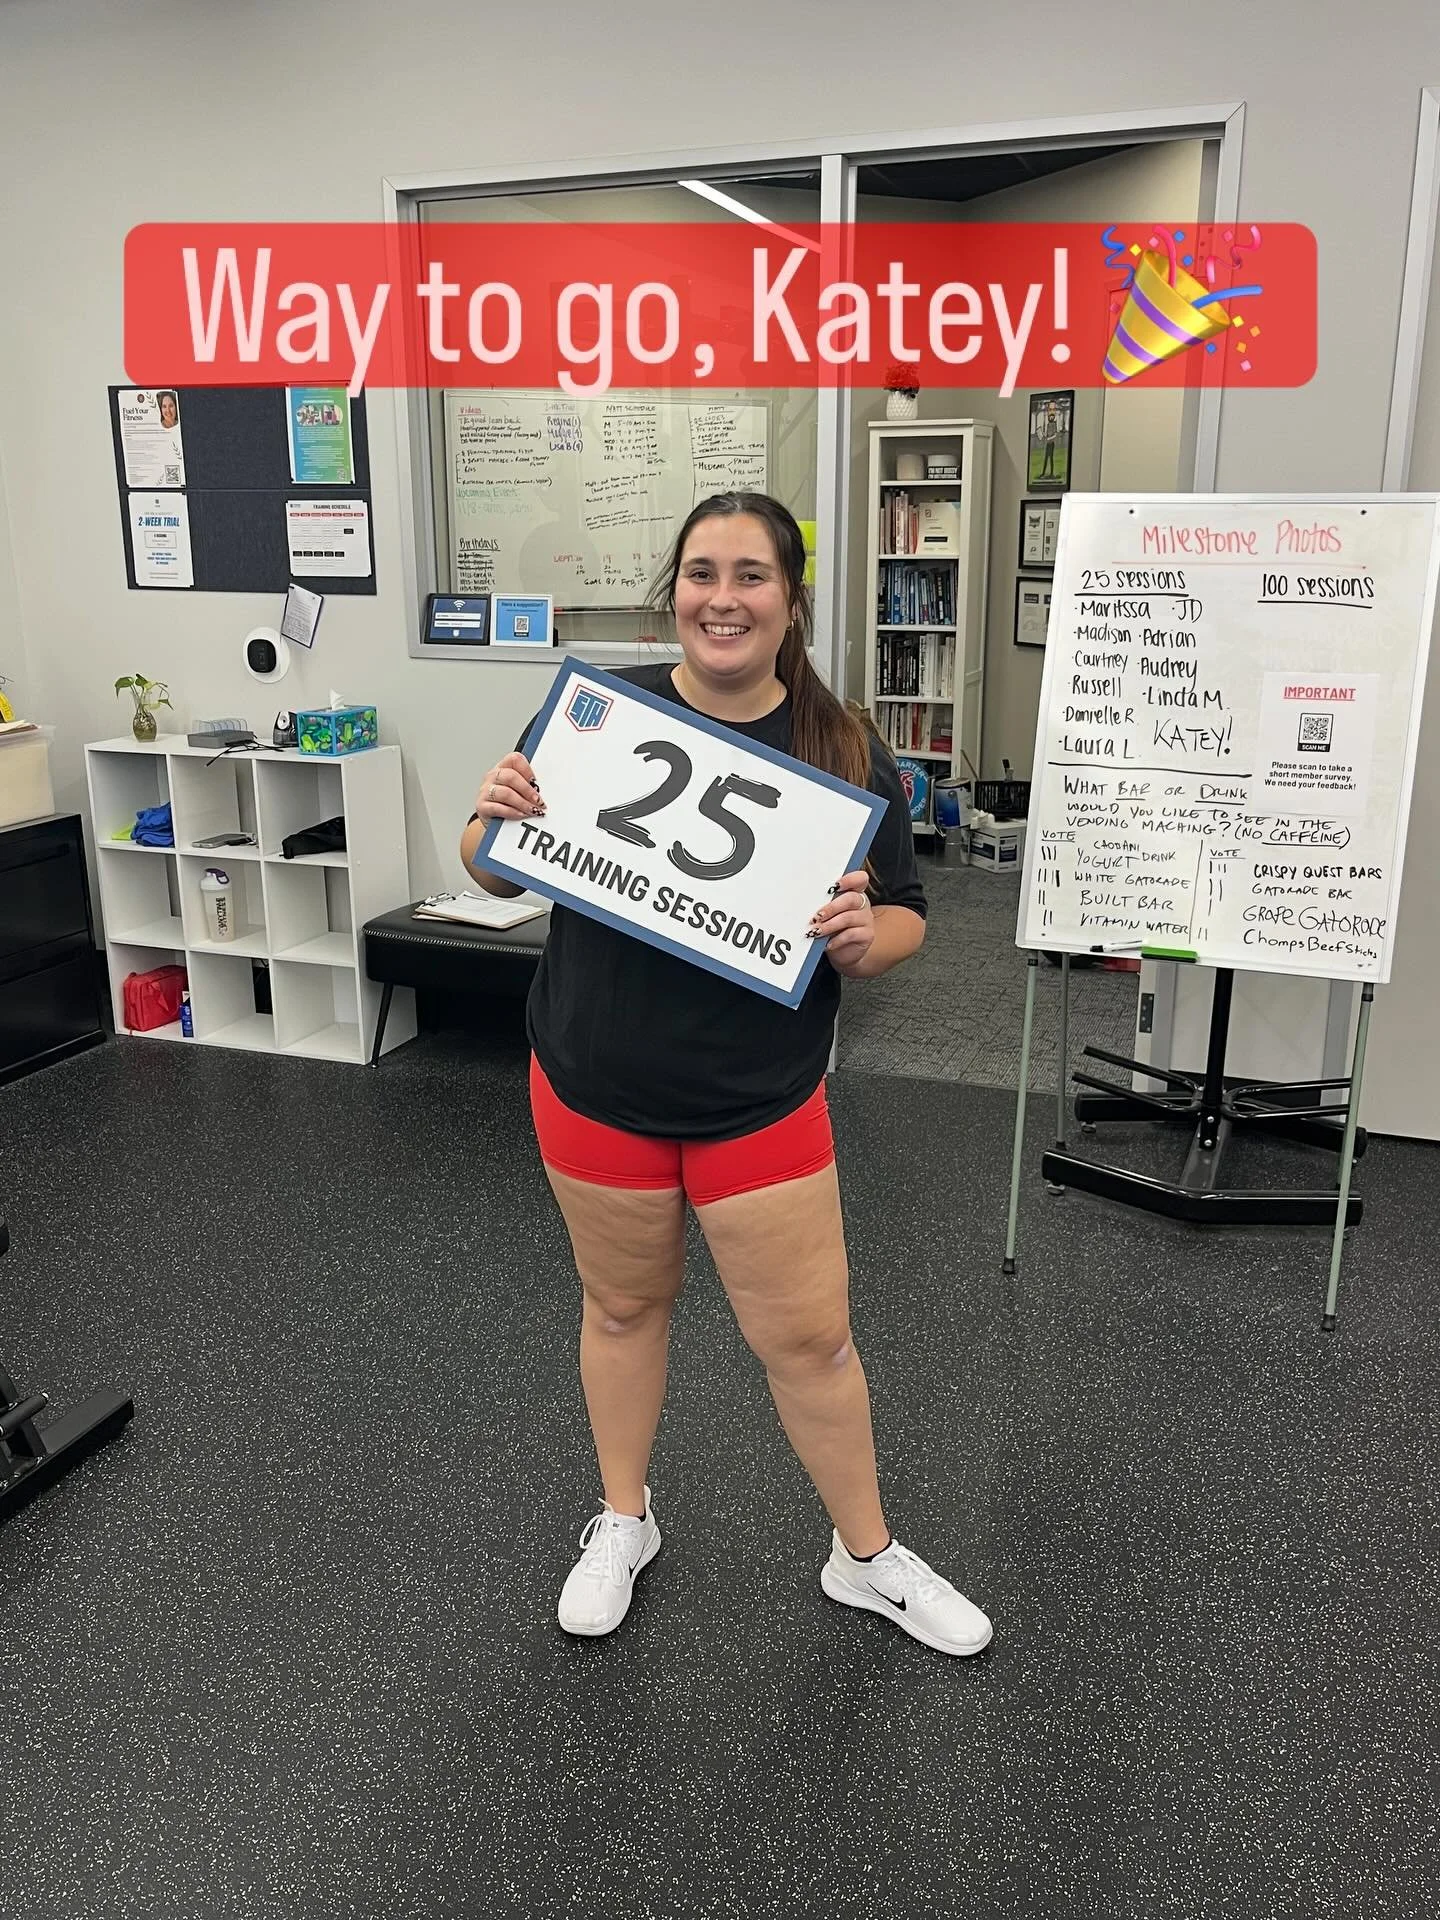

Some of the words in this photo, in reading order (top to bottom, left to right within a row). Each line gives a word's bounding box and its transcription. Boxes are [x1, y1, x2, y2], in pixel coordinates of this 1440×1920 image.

[138, 516, 162, 527] 2-WEEK
[163, 516, 180, 527] TRIAL
[1142, 525, 1258, 555] Milestone
[1275, 519, 1342, 554] Photos
[1081, 569, 1110, 589] 25
[1116, 568, 1186, 589] sessions
[1262, 574, 1288, 597] 100
[1297, 574, 1374, 599] sessions
[1175, 598, 1204, 624] JD
[1077, 622, 1132, 644] Madison
[1143, 628, 1196, 648] Adrian
[1074, 650, 1128, 674] Courtney
[1072, 674, 1122, 698] Russell
[1140, 656, 1198, 694] Audrey
[1148, 686, 1198, 708] Linda
[1284, 686, 1356, 700] IMPORTANT
[1065, 705, 1122, 726] Danielle
[1064, 735, 1114, 758] Laura
[1154, 715, 1233, 758] KATEY!
[1317, 744, 1327, 752] ME
[1269, 770, 1290, 778] short
[1290, 772, 1323, 780] member
[1324, 774, 1353, 783] survey.
[1271, 762, 1297, 770] Please
[1328, 764, 1346, 772] take
[1064, 775, 1108, 796] WHAT
[1118, 780, 1152, 797] BAR
[1164, 786, 1186, 796] OR
[1200, 783, 1248, 800] DRINK
[1278, 780, 1296, 788] need
[1317, 782, 1356, 790] feedback!
[596, 740, 782, 881] 25
[1067, 802, 1120, 815] WOULD
[1130, 806, 1153, 819] YOU
[1162, 808, 1202, 819] LIKE
[1208, 809, 1229, 822] TO
[1234, 812, 1272, 826] SEE
[1275, 818, 1290, 828] IN
[1299, 818, 1337, 831] THE
[1042, 830, 1076, 840] VOTE
[1066, 816, 1129, 829] VENDING
[1234, 823, 1263, 840] (NO
[1269, 826, 1351, 850] CAFFEINE)
[1077, 848, 1140, 870] YOGURT
[1142, 851, 1176, 862] DRINK
[1210, 849, 1240, 858] VOTE
[1074, 870, 1117, 884] WHITE
[1124, 874, 1192, 890] GATORADE
[1254, 863, 1298, 880] CRISPY
[1303, 866, 1343, 879] QUEST
[1350, 866, 1383, 880] BARS
[516, 822, 650, 902] TRAINING
[652, 886, 792, 966] SESSIONS
[1080, 889, 1134, 906] BUILT
[1138, 896, 1174, 910] BAR
[1252, 883, 1319, 896] GATORADE
[1080, 912, 1140, 930] VITAMIN
[1146, 920, 1189, 935] WATER
[1244, 928, 1304, 952] Chomps
[1308, 936, 1345, 952] Beef
